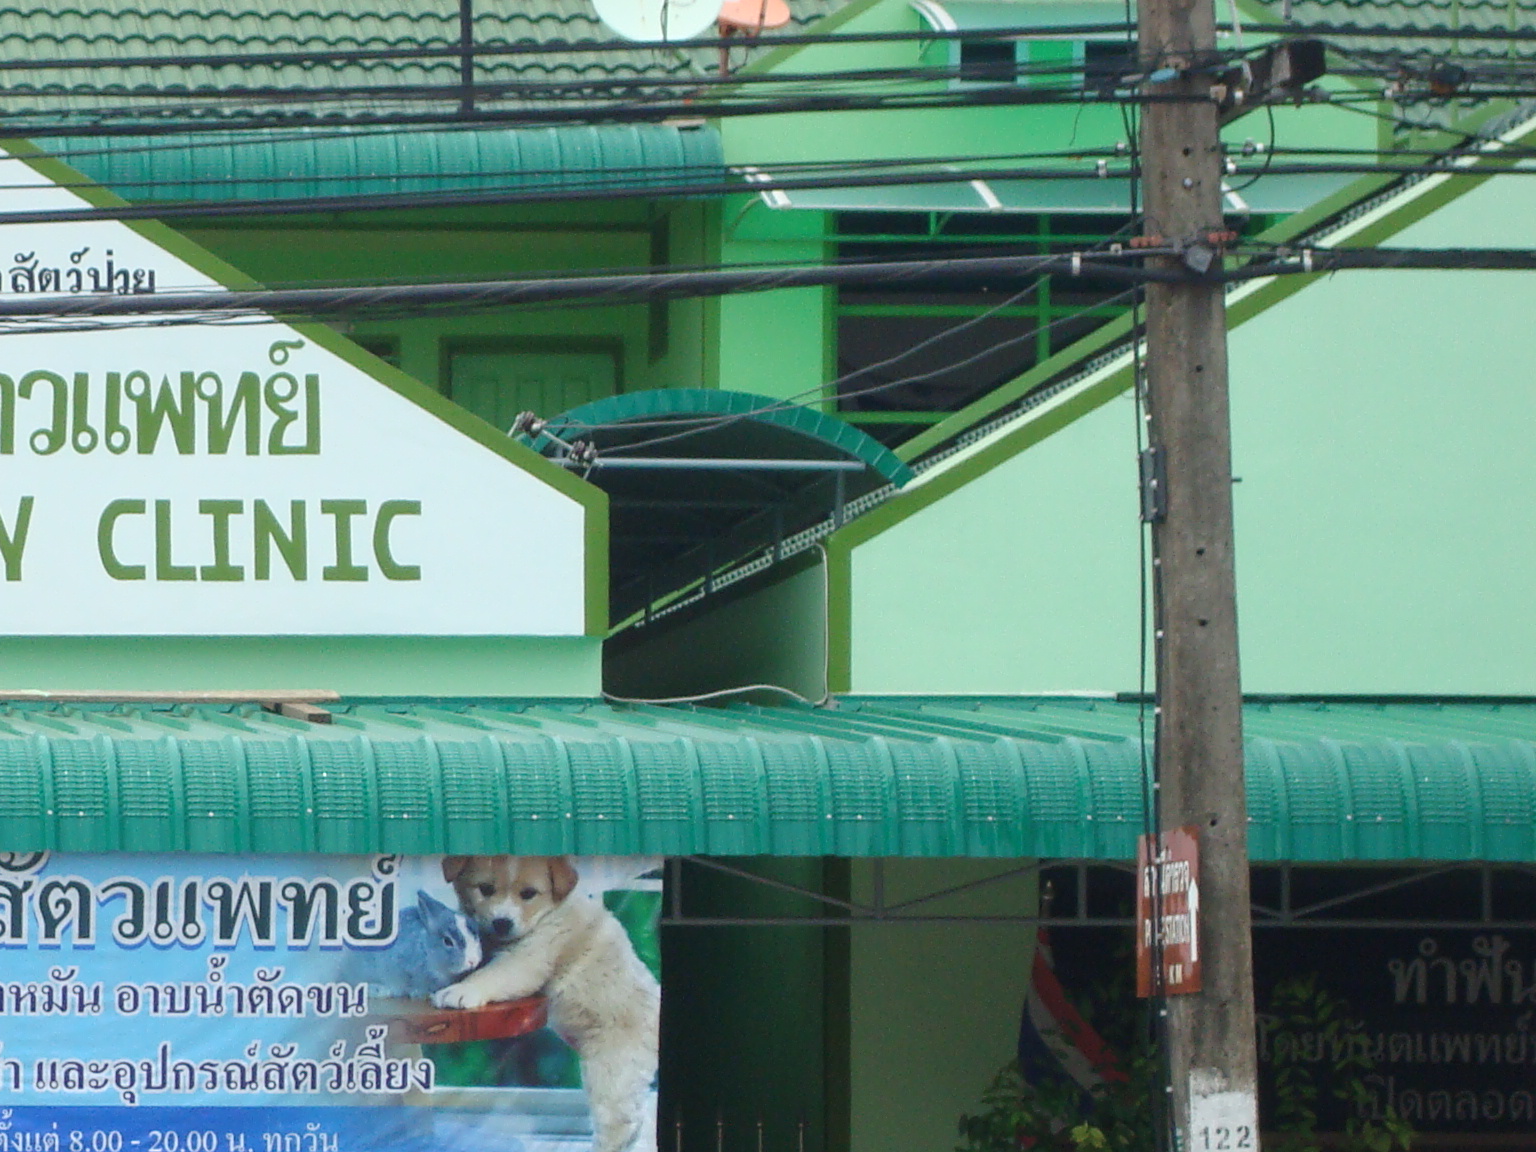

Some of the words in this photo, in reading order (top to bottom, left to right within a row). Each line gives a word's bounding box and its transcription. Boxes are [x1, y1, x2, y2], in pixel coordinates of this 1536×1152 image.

[96, 497, 422, 582] CLINIC
[115, 955, 367, 1015] อาบน้ำตัดขน
[34, 1025, 435, 1106] และอุปกรณ์สัตว์เลี้ยง
[69, 1130, 122, 1152] 8.00
[147, 1130, 217, 1152] 20.00
[225, 1133, 254, 1152] น.
[1199, 1125, 1251, 1151] 122
